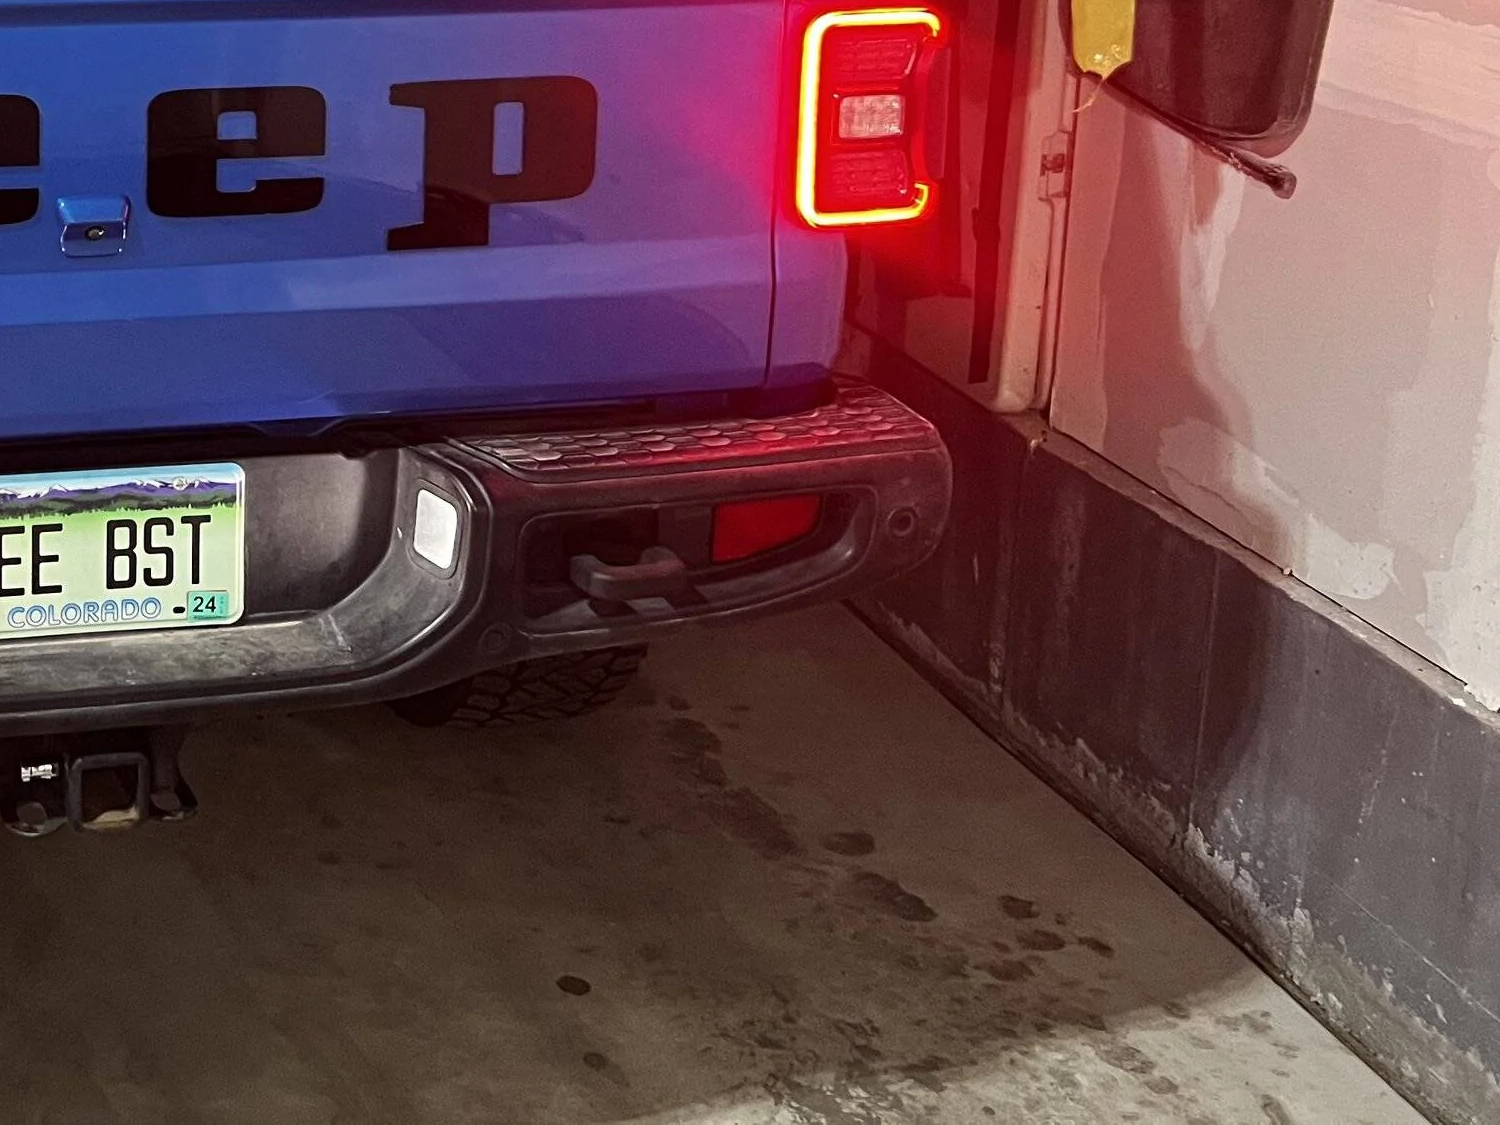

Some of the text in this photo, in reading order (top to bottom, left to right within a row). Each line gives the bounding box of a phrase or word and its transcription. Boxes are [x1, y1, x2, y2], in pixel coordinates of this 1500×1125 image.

[105, 515, 211, 591] BST
[7, 597, 162, 629] COLORADO
[192, 595, 217, 613] 24
